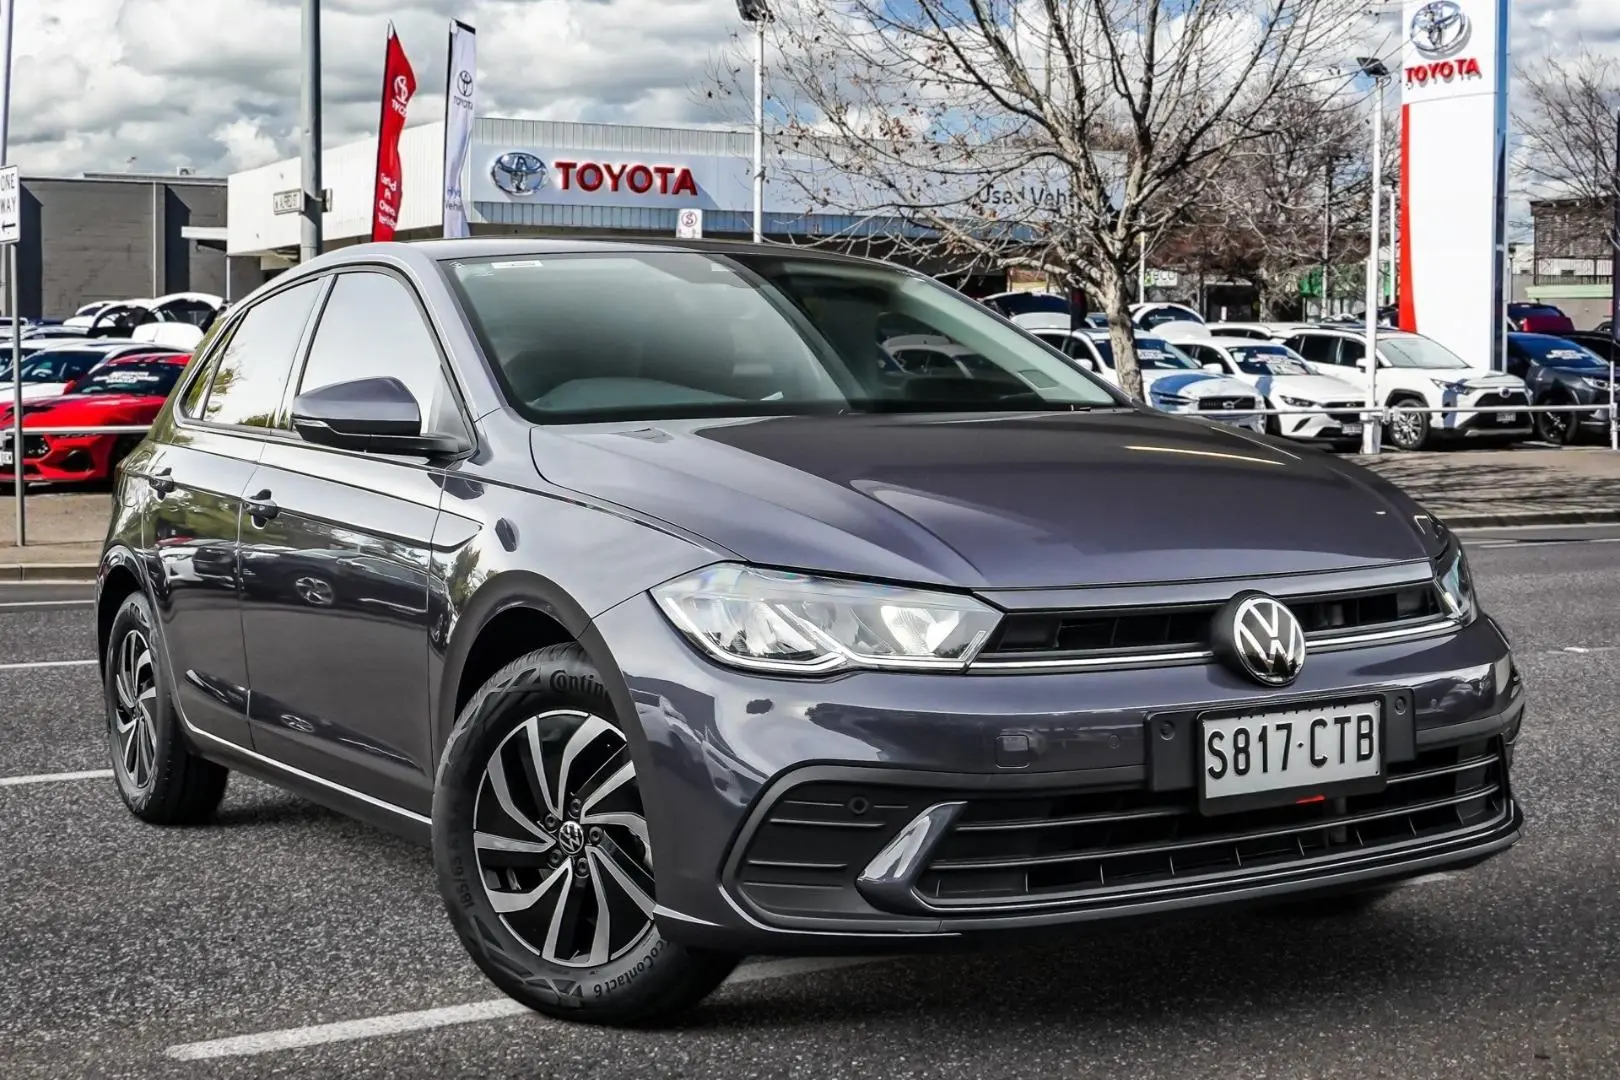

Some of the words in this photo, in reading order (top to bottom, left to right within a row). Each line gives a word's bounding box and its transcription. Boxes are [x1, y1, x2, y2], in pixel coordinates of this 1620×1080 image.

[1404, 58, 1481, 83] TOYOTA
[1, 173, 15, 191] ONE
[555, 161, 698, 196] TOYOTA
